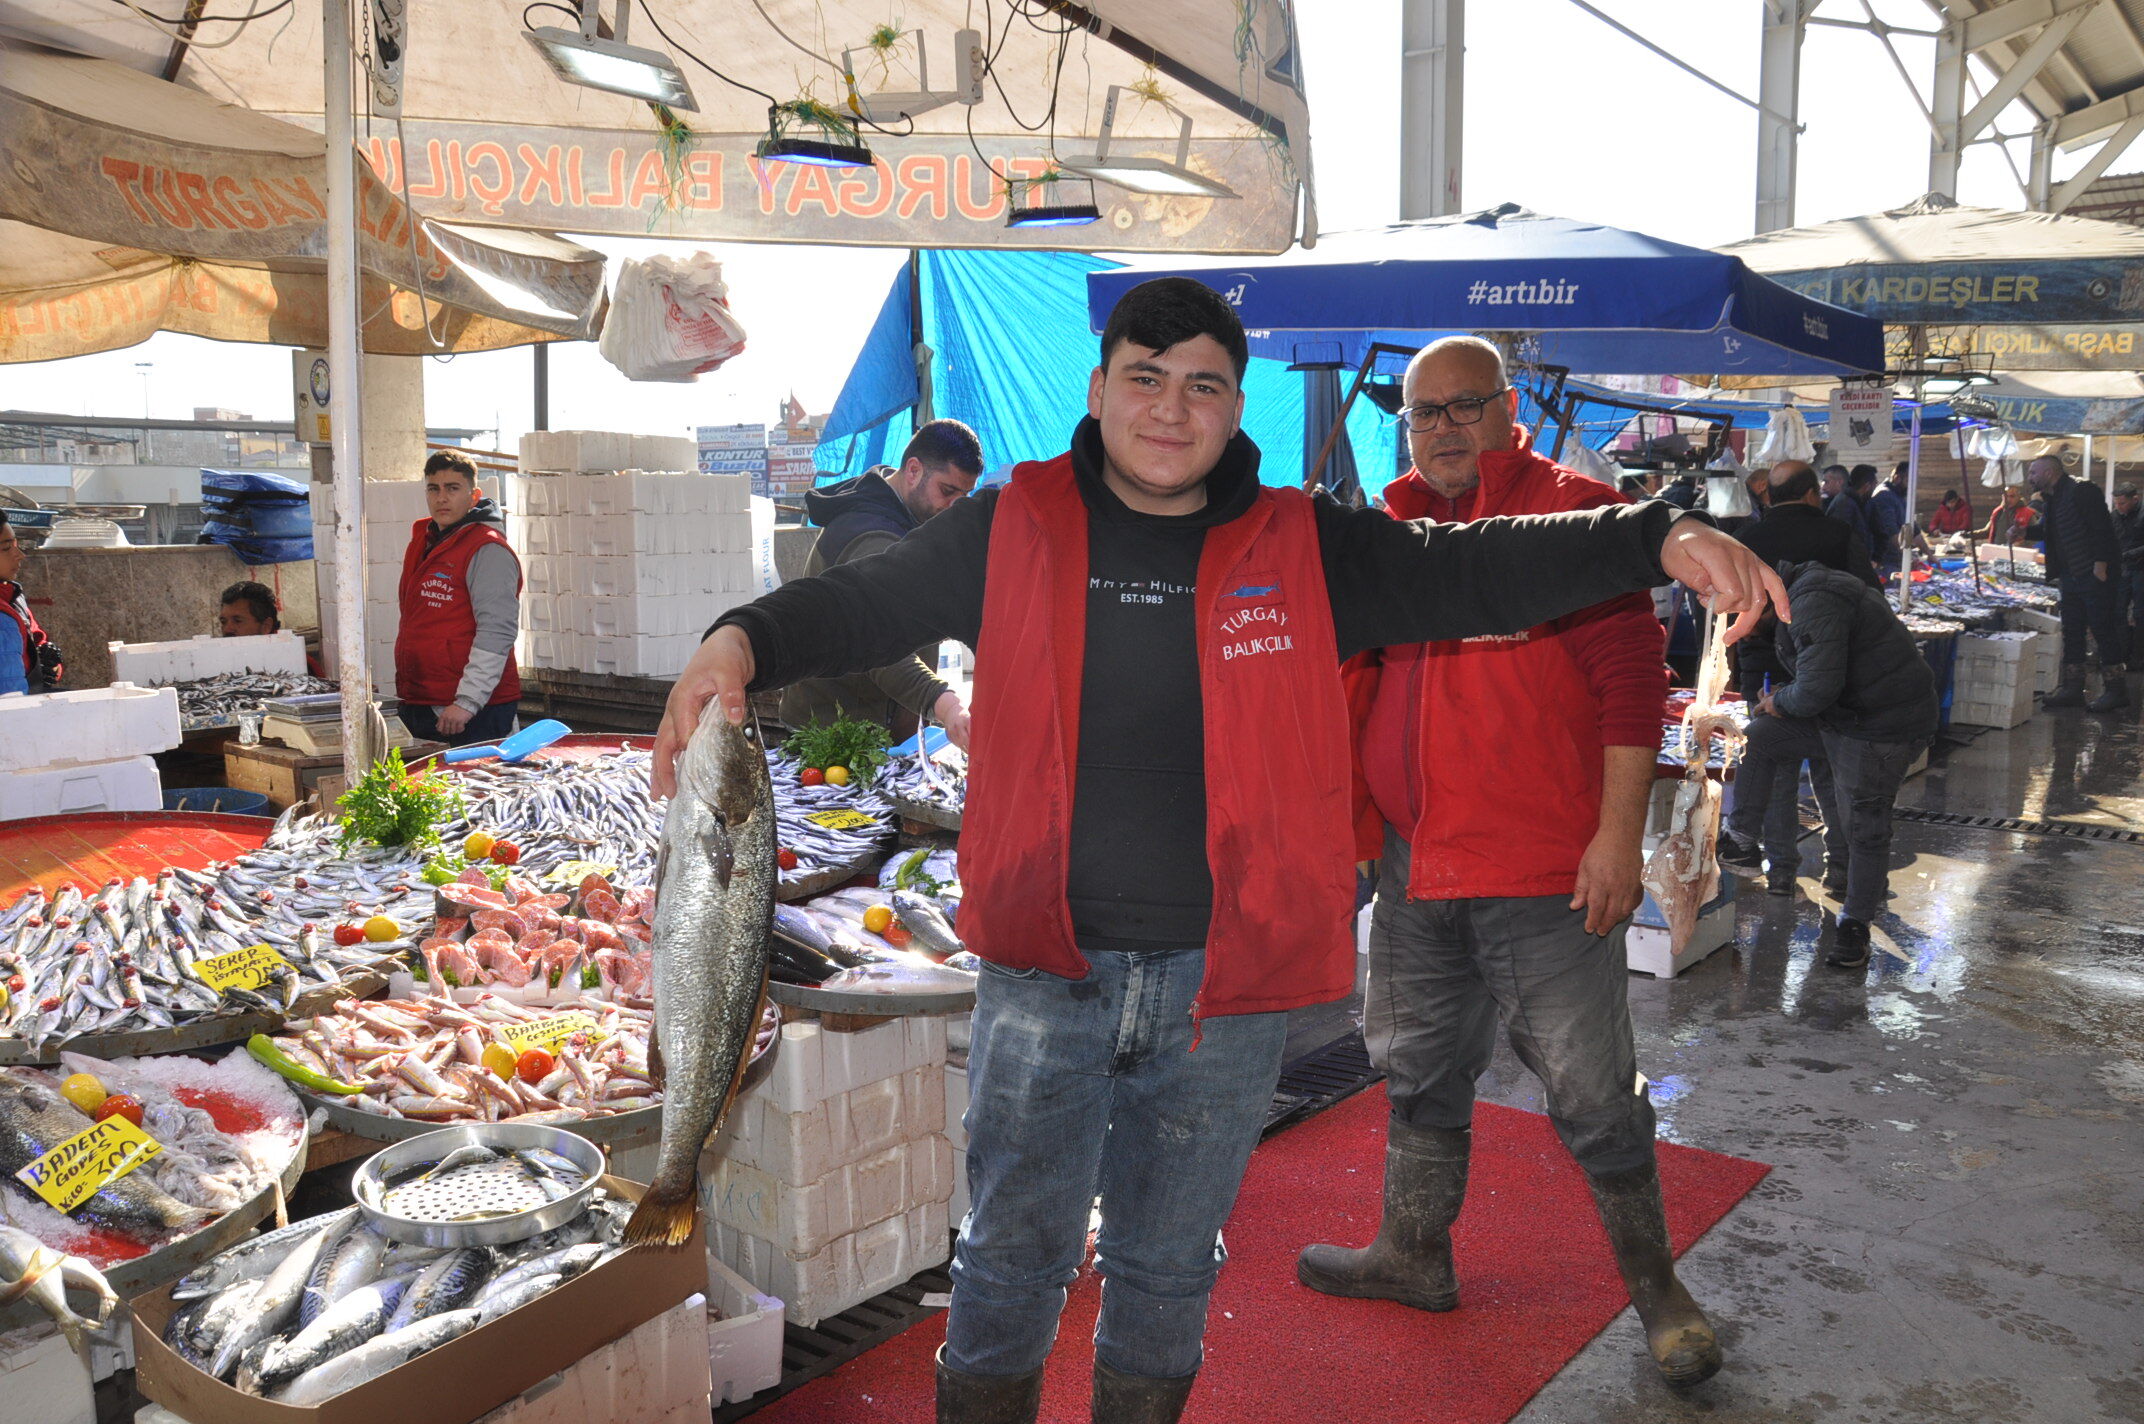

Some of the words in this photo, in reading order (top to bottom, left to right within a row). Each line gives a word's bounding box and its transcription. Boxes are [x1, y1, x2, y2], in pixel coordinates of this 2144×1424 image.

[102, 156, 328, 231] TURGAY
[1467, 278, 1580, 306] #artıbir
[1841, 275, 2040, 309] KARDEŞLER
[704, 450, 765, 461] KONTUR
[421, 580, 454, 593] TURGAY
[1120, 593, 1164, 604] EST.1985
[1220, 607, 1289, 635] TURGAY
[1222, 635, 1294, 660] BALIKÇILIK
